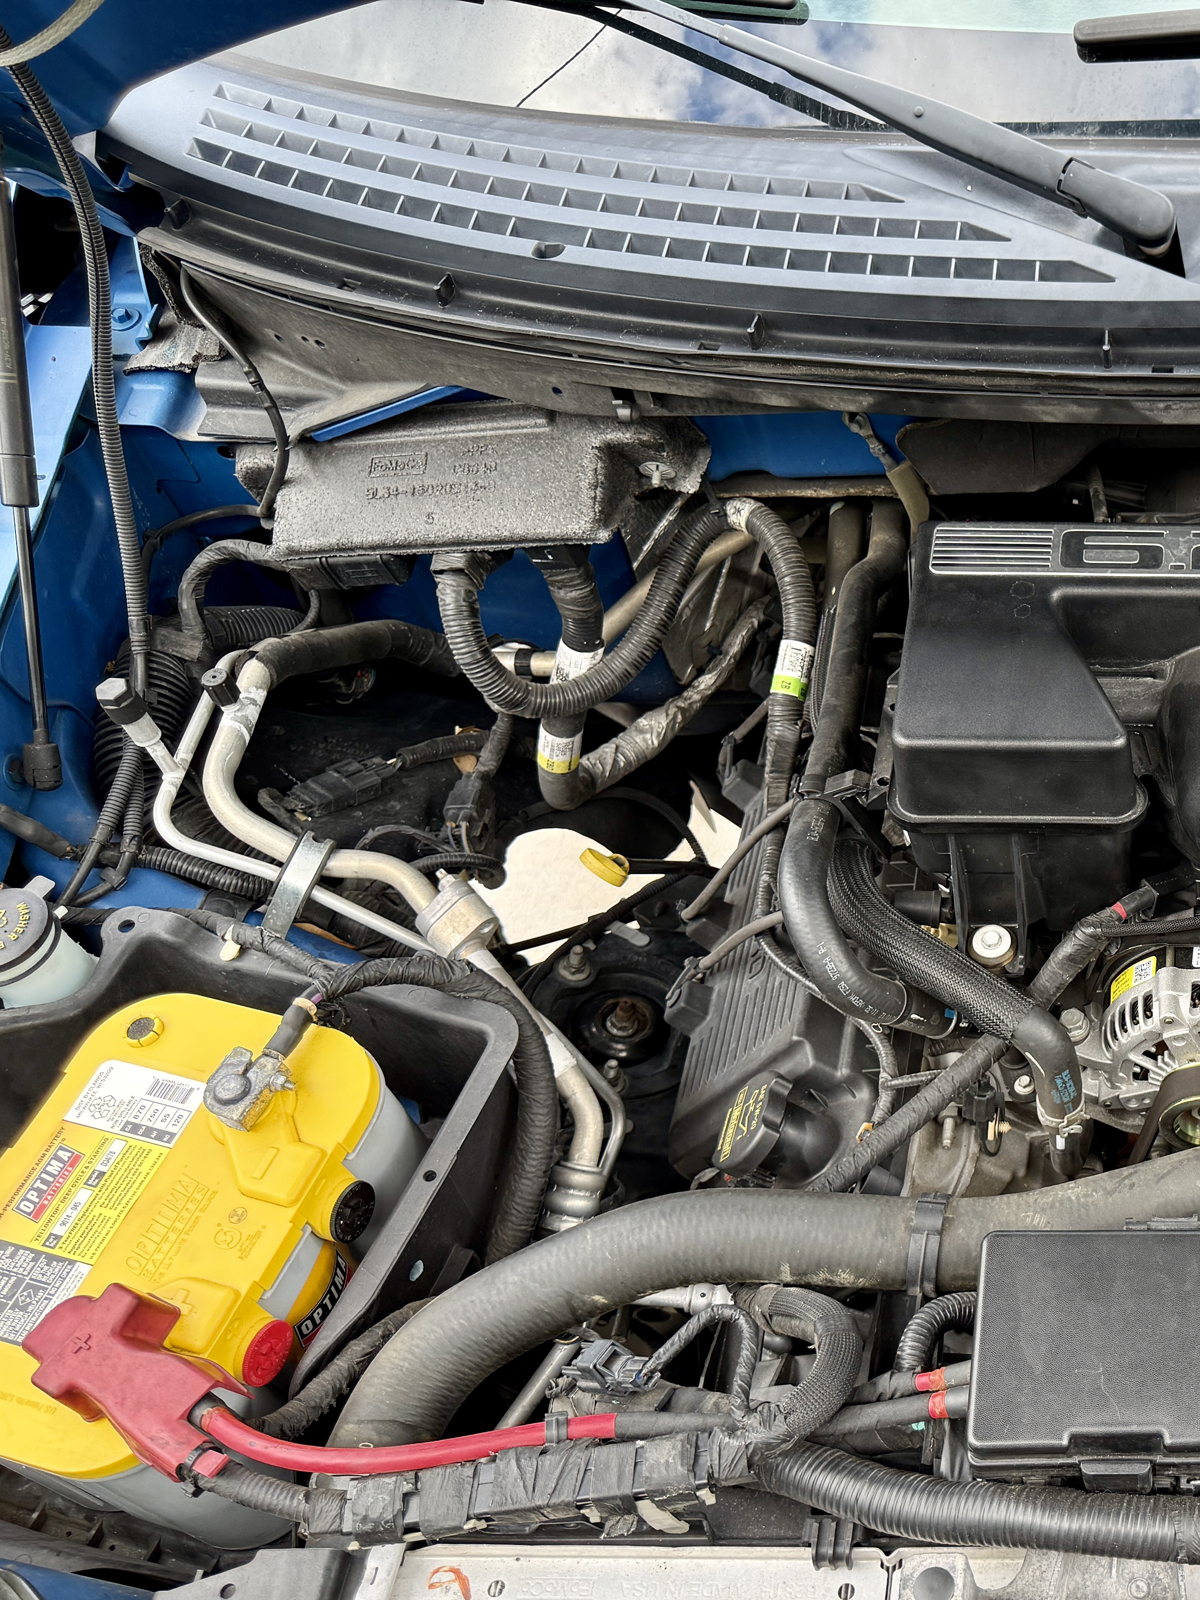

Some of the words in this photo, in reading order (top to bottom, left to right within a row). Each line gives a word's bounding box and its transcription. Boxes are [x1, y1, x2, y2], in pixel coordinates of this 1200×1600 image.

[7, 902, 31, 941] WASHER
[146, 1108, 159, 1122] 750
[159, 1113, 170, 1122] 55
[170, 1114, 184, 1127] 120
[34, 1151, 48, 1166] AGM
[44, 1126, 66, 1152] BATTERY
[18, 1145, 72, 1215] OPTIMA
[42, 1164, 73, 1205] BATTERIES
[59, 1188, 74, 1203] DEEP
[70, 1169, 86, 1188] CYCLE
[87, 1137, 110, 1164] STARTING
[68, 1222, 79, 1234] FREE
[122, 1175, 197, 1272] OPTIMA
[139, 1185, 209, 1279] BATTERIES
[301, 1255, 347, 1336] OPTIMA
[520, 1582, 595, 1598] FoMoCo
[619, 1581, 660, 1598] USA
[689, 1580, 740, 1598] MADE
